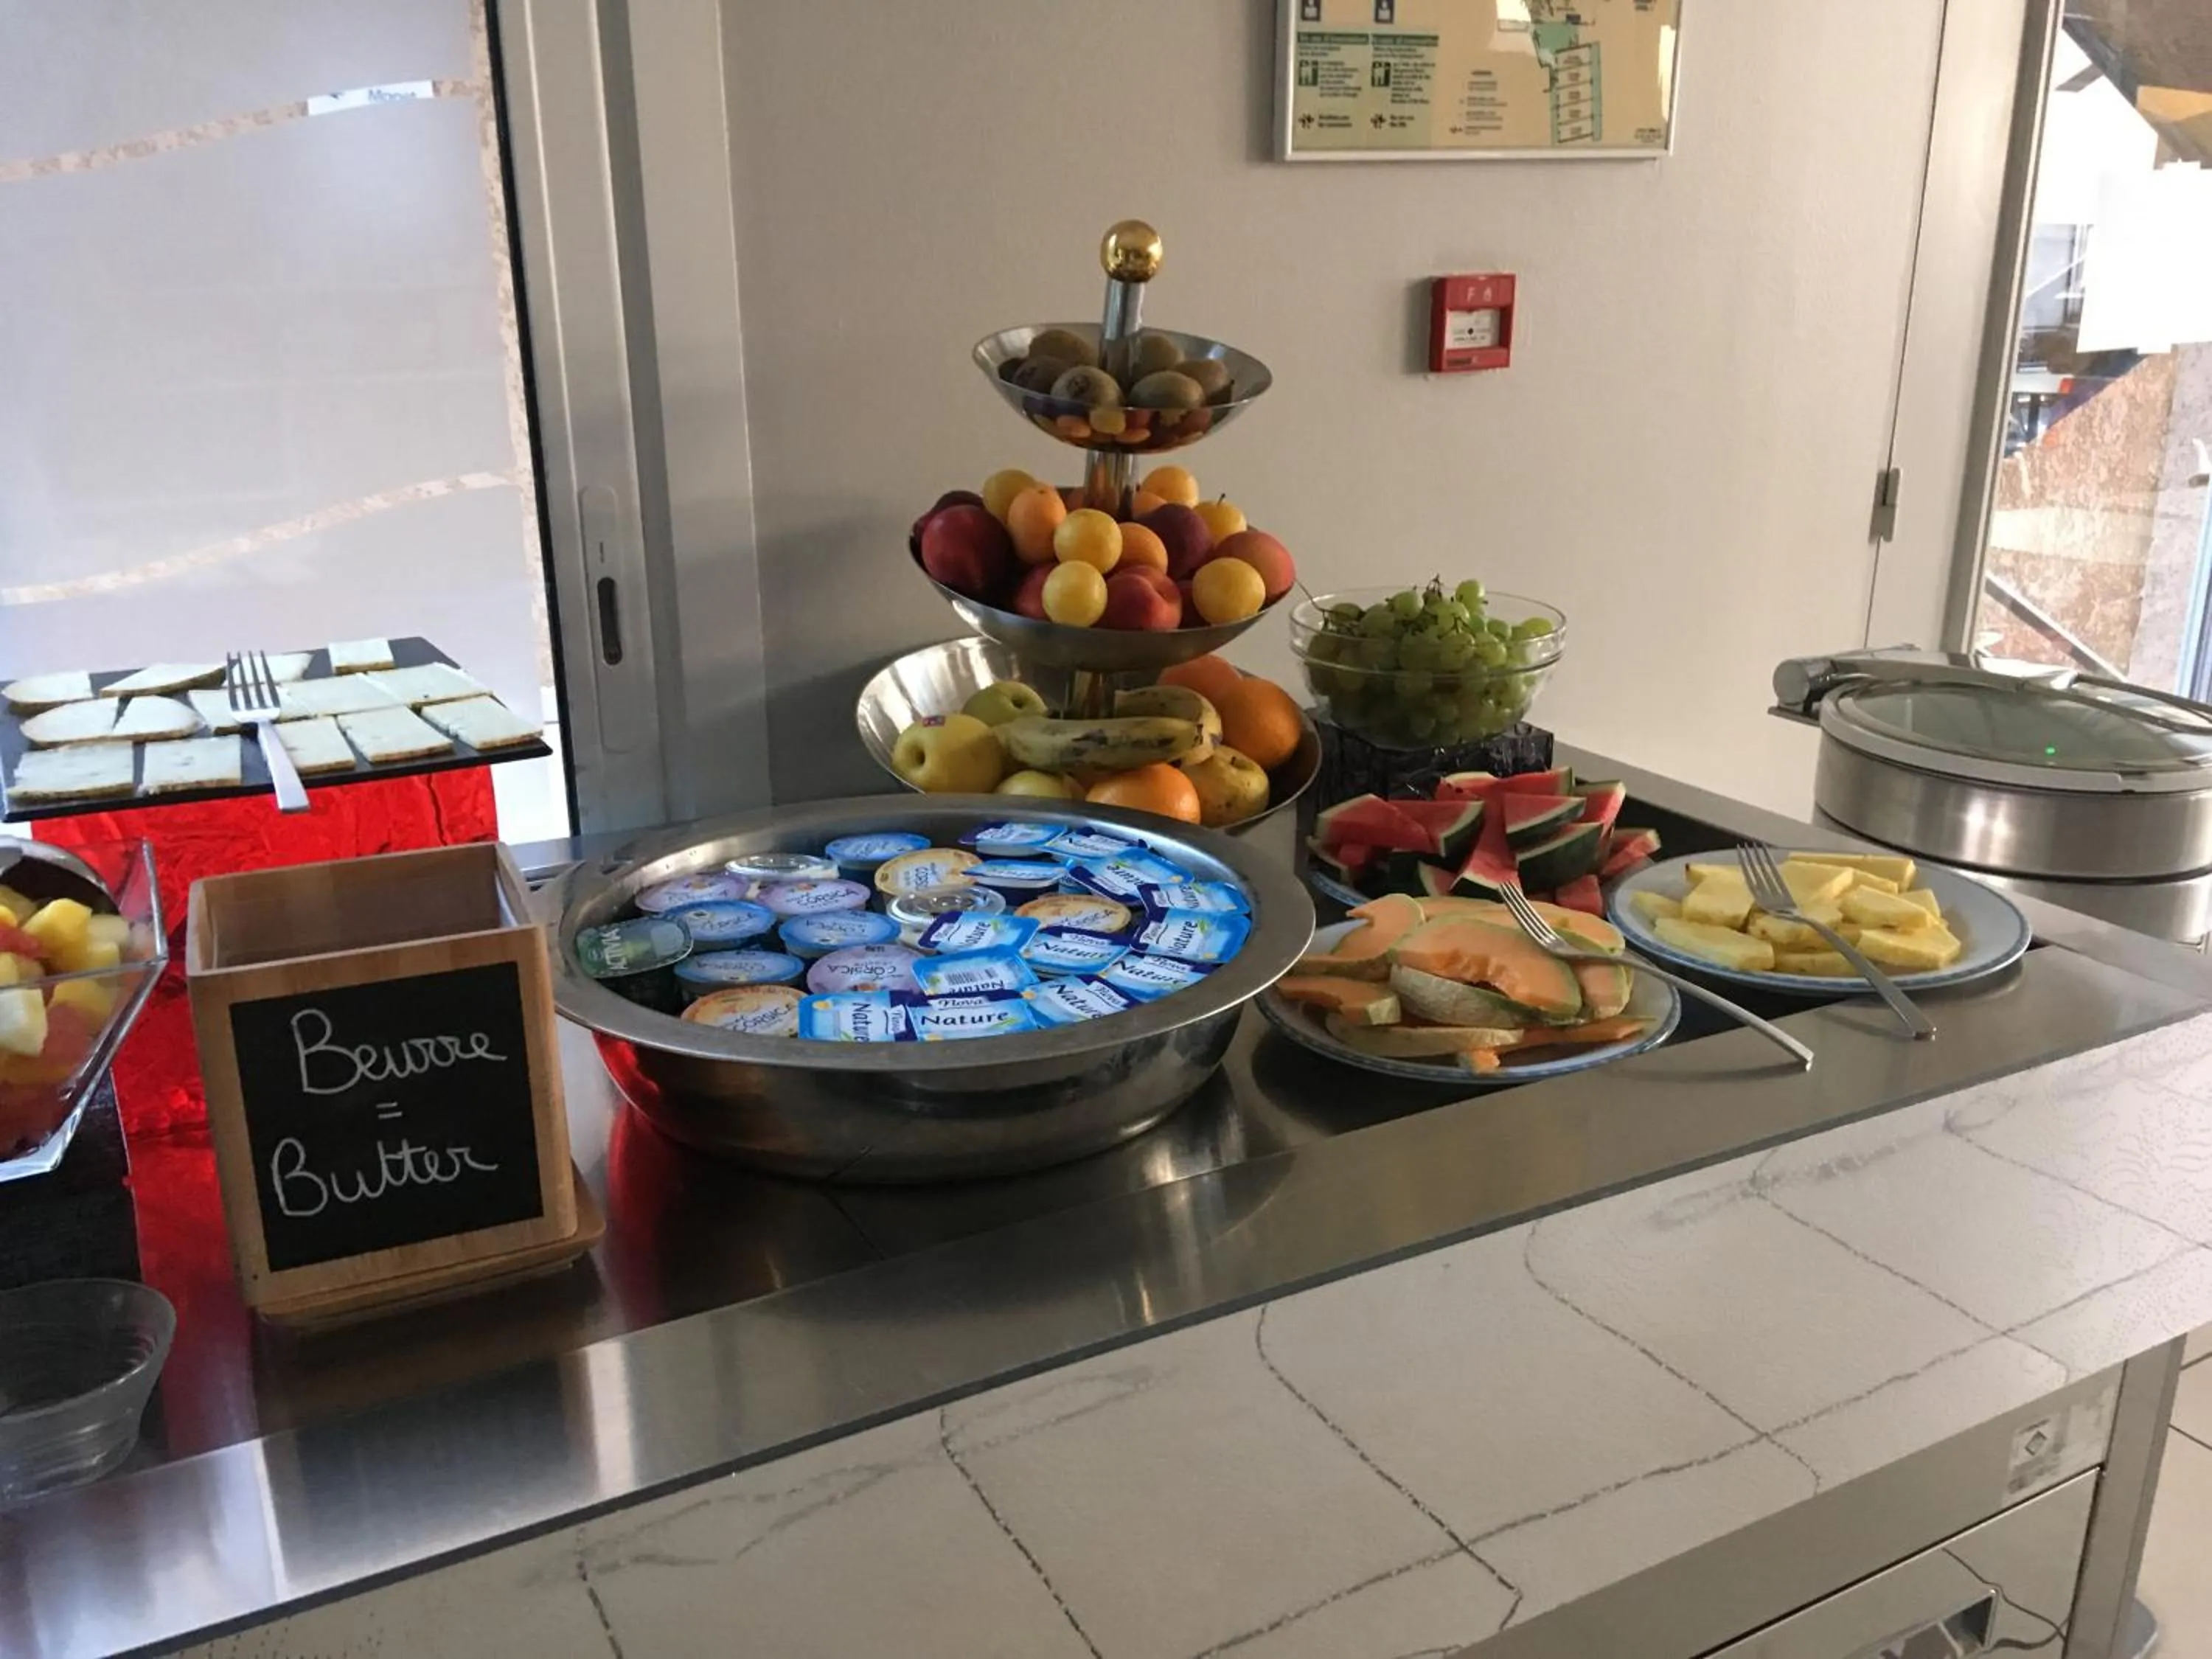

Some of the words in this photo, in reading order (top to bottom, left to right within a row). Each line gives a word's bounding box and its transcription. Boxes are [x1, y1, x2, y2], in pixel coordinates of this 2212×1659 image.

[1106, 865, 1145, 885] ature
[827, 964, 897, 975] CORSICA
[1113, 961, 1188, 984] Nature
[1049, 984, 1102, 1019] Nature
[852, 1002, 872, 1043] Nature
[922, 1012, 1009, 1026] Nature
[375, 1102, 403, 1120] =
[271, 1137, 499, 1217] Butter
